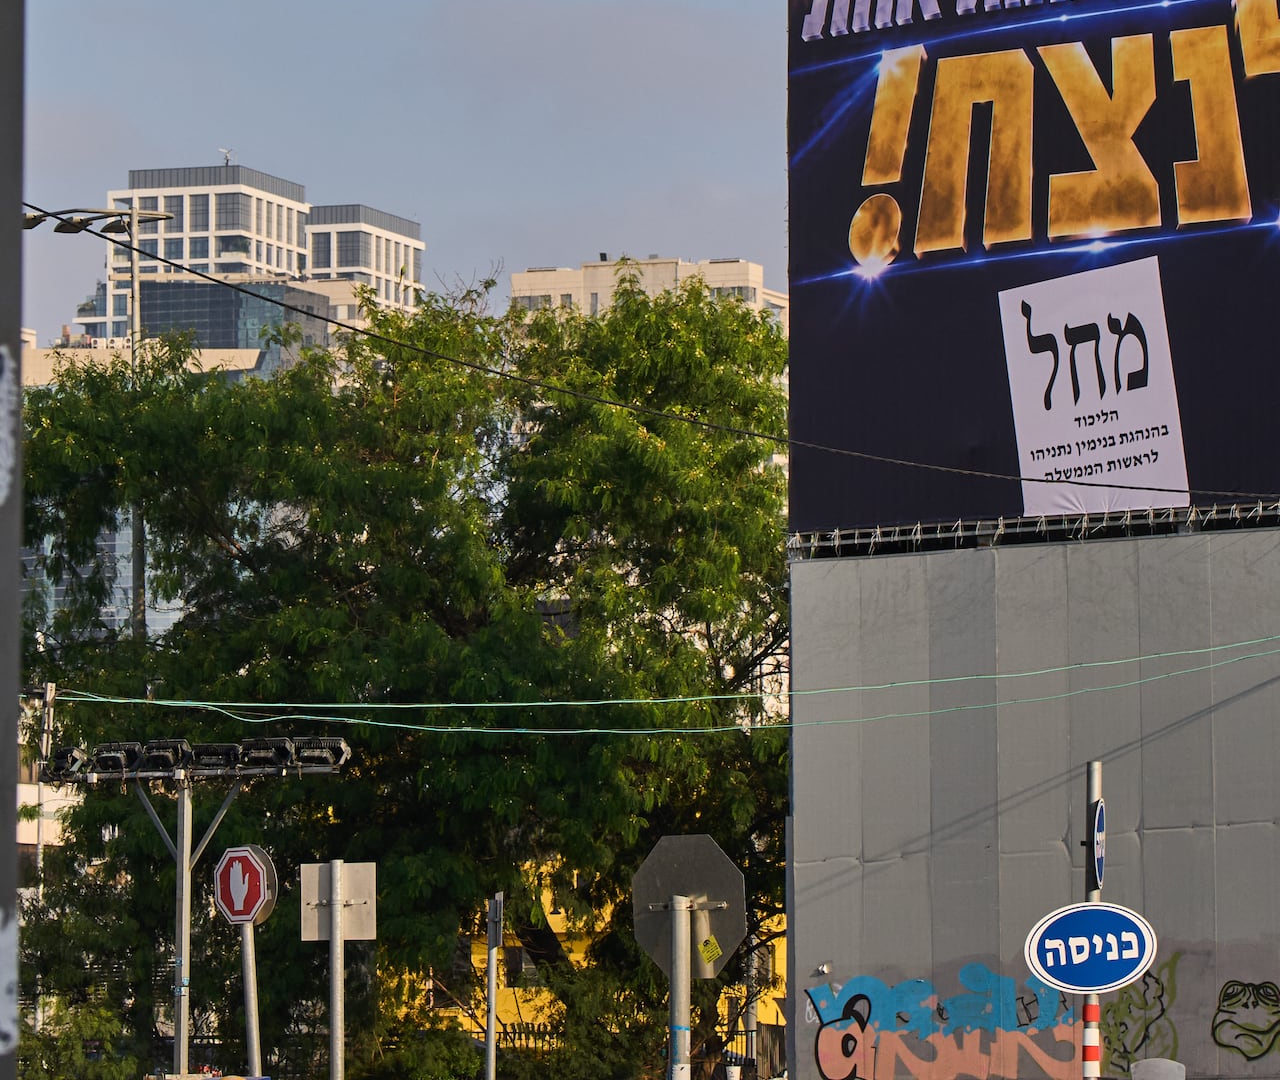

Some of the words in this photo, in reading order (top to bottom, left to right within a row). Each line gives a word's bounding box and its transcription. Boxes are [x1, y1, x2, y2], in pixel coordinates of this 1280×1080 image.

[1021, 299, 1149, 411] מחל
[1073, 409, 1119, 429] הליכוד
[1075, 433, 1116, 457] בנימין
[1119, 423, 1170, 445] בהנהגת
[1030, 443, 1072, 462] נתניהו
[1106, 448, 1159, 472] לראשות
[1044, 461, 1103, 483] הממשלה
[1045, 929, 1142, 968] כניסה
